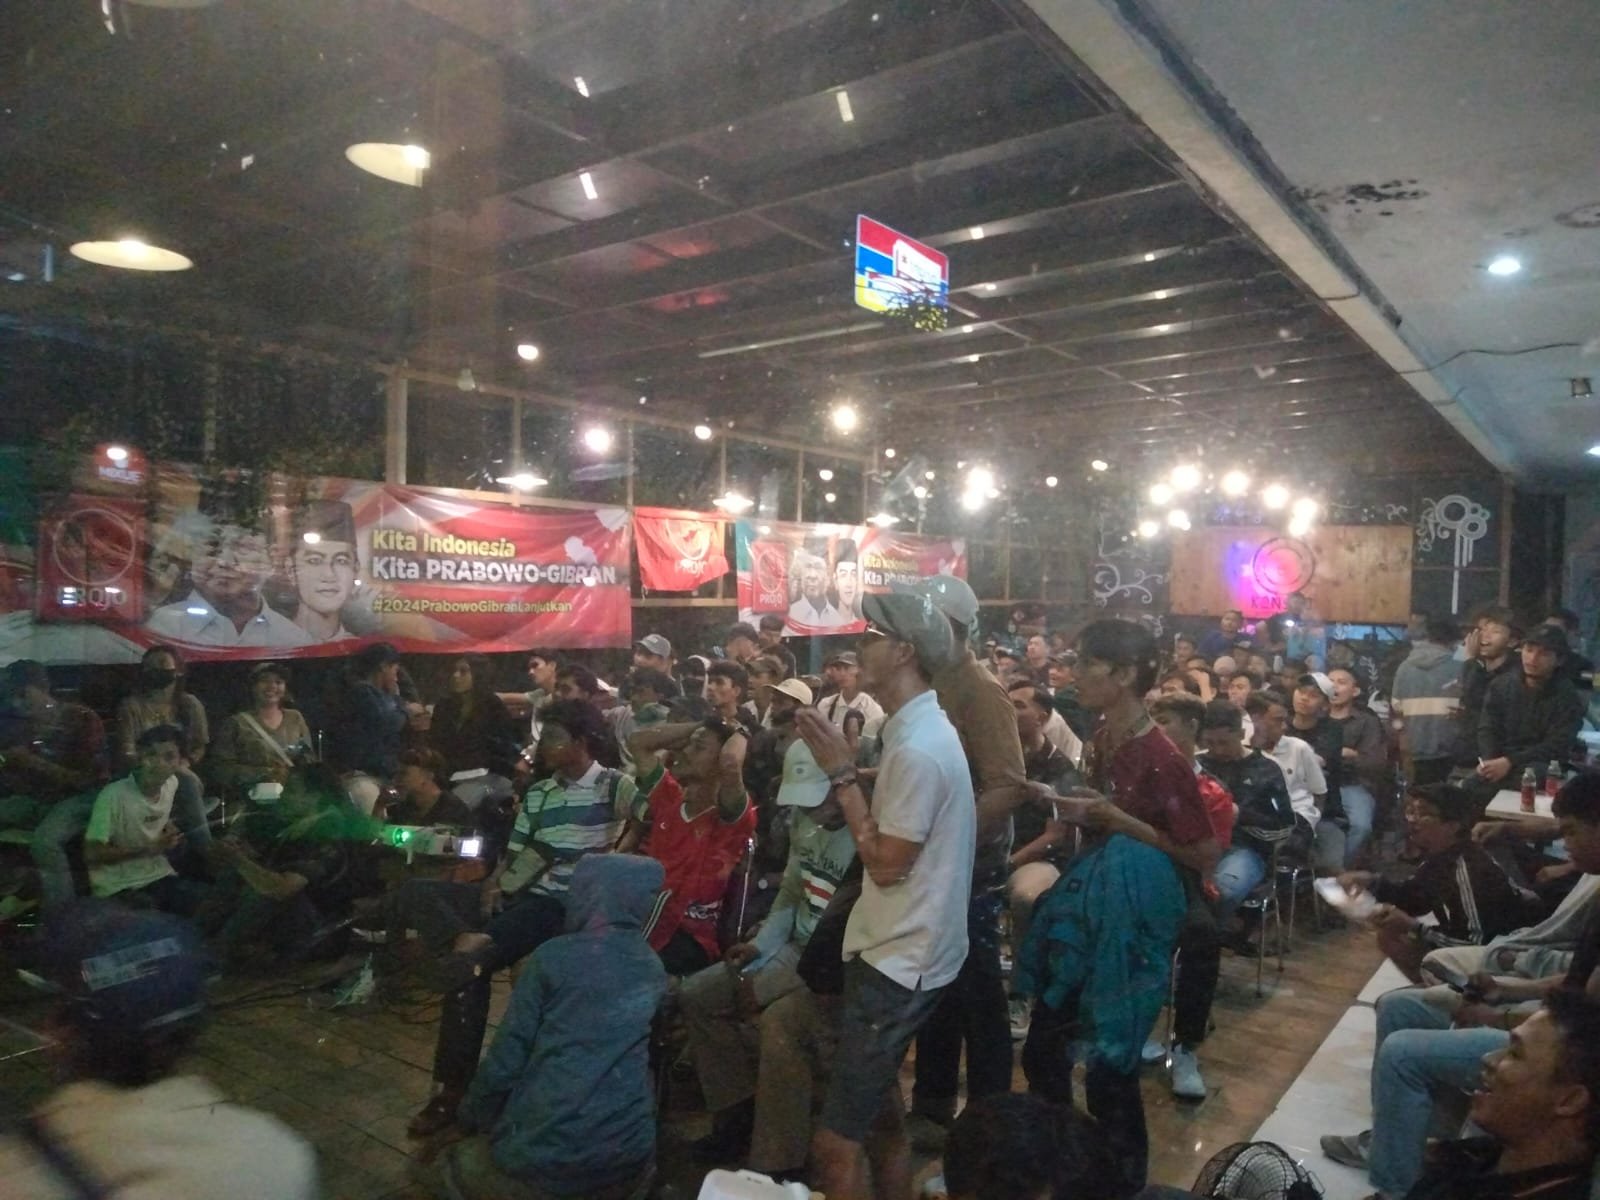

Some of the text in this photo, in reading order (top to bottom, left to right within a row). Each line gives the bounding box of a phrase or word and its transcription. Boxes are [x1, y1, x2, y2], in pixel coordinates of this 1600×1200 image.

[373, 529, 515, 557] Kita Indonesia
[373, 556, 616, 585] Kita PRABOWO-GIBRAN
[373, 597, 573, 614] #2024PrabowoGibranLanjutkan
